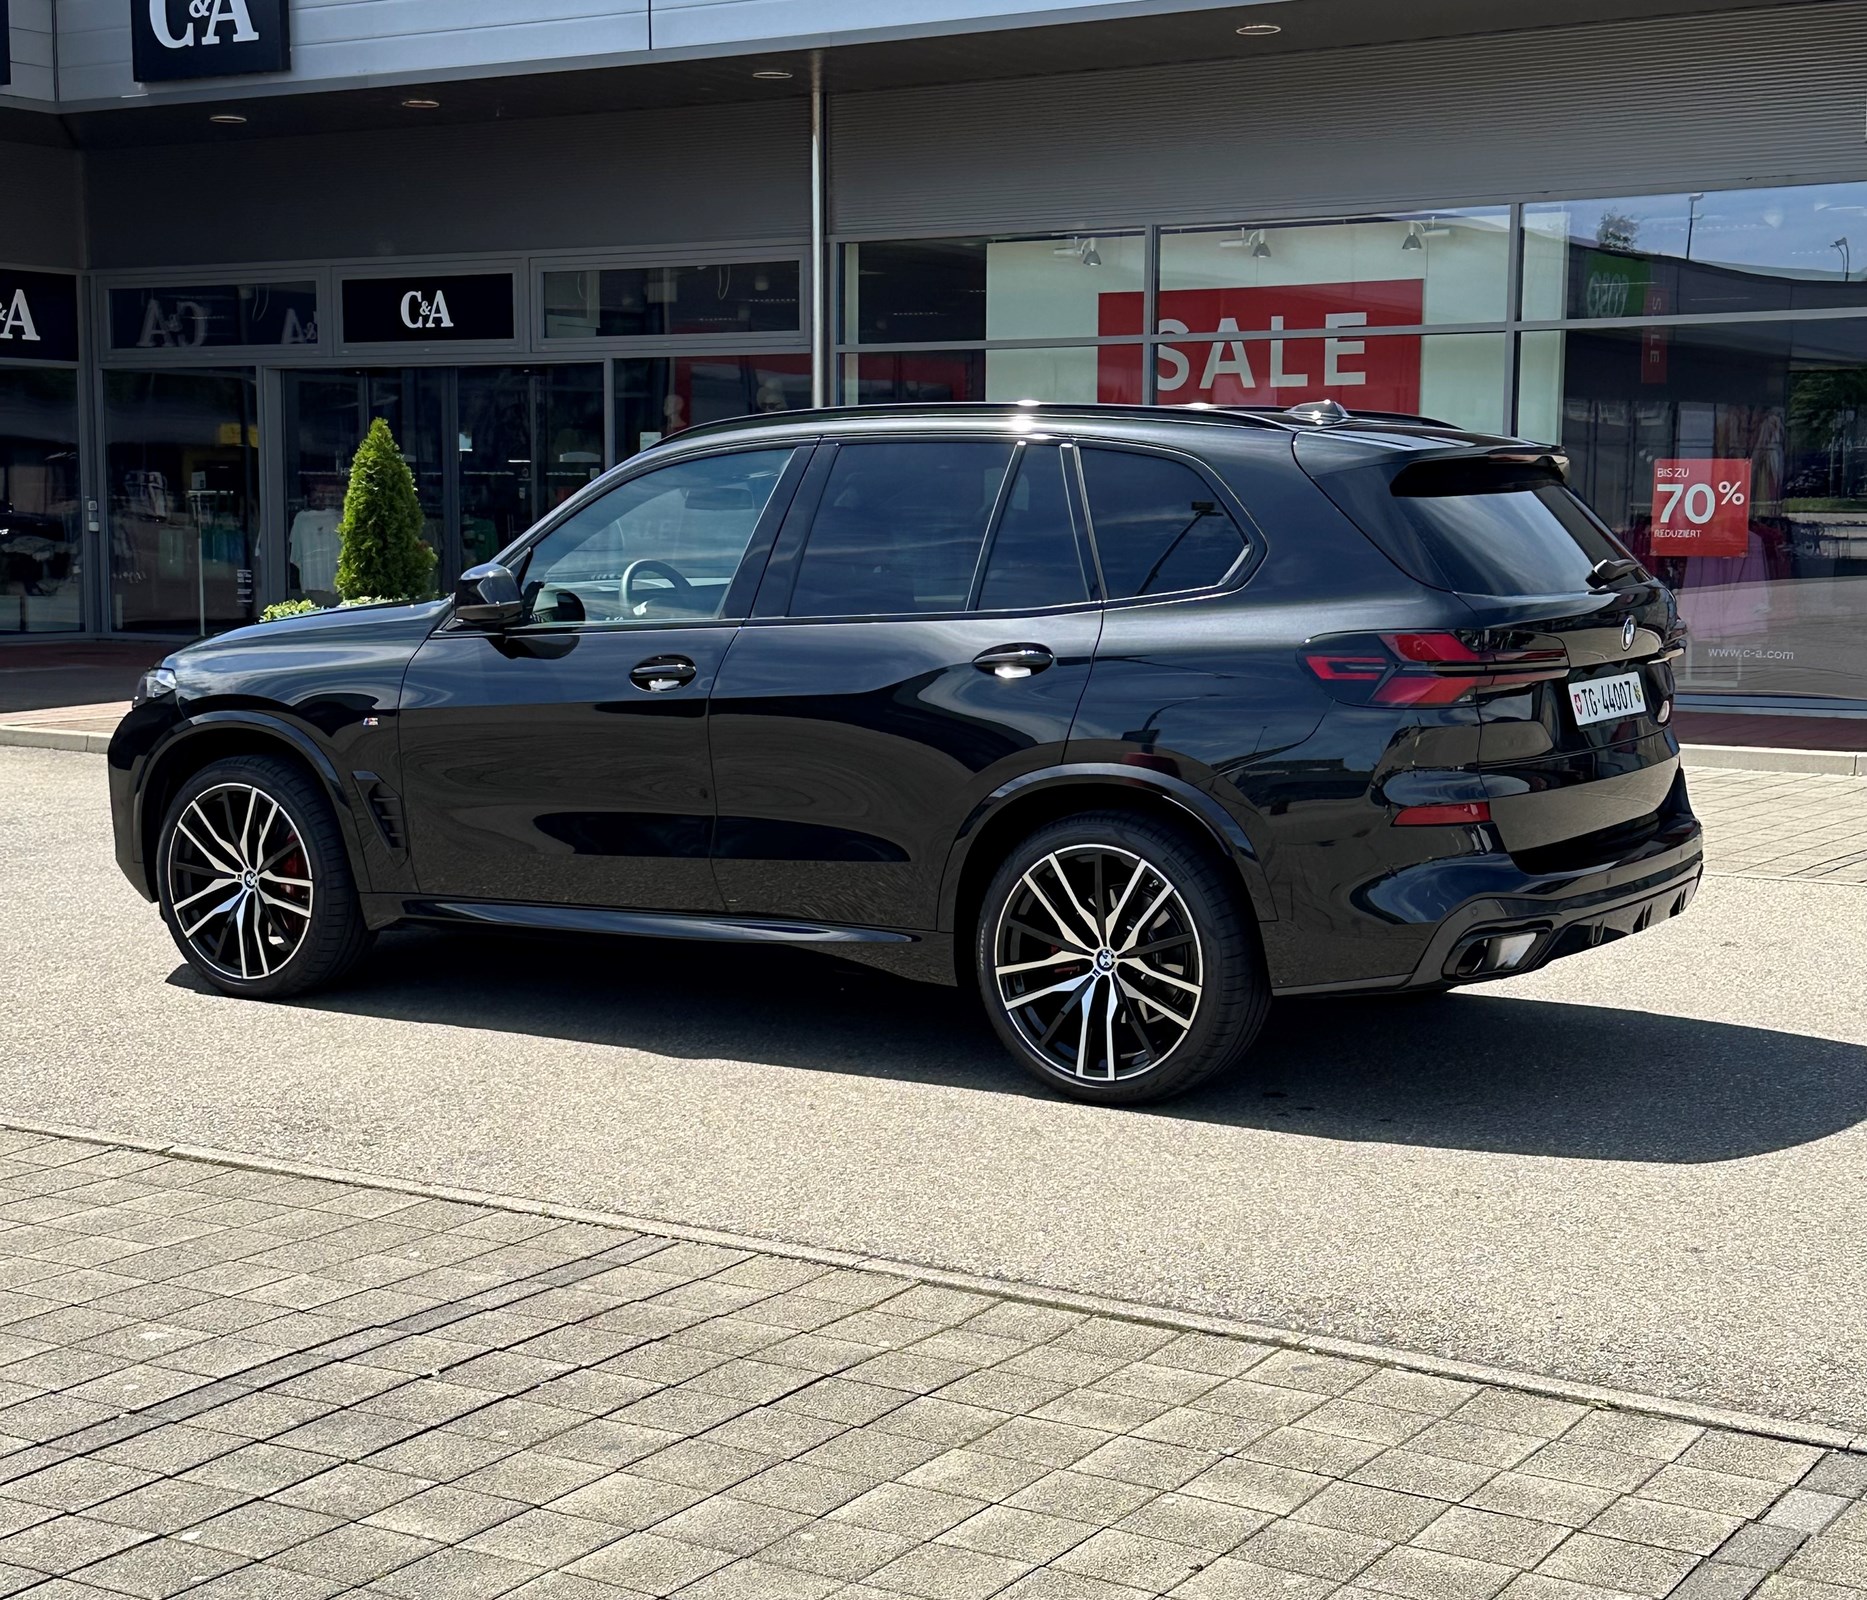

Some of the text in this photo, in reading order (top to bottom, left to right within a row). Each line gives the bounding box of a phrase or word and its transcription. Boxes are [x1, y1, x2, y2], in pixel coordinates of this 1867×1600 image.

[149, 0, 259, 48] C&A
[400, 290, 454, 328] C&A
[1650, 296, 1662, 363] SLE
[1157, 312, 1367, 391] SALE
[1674, 467, 1690, 478] ZU
[1708, 647, 1794, 660] www.c-a.com
